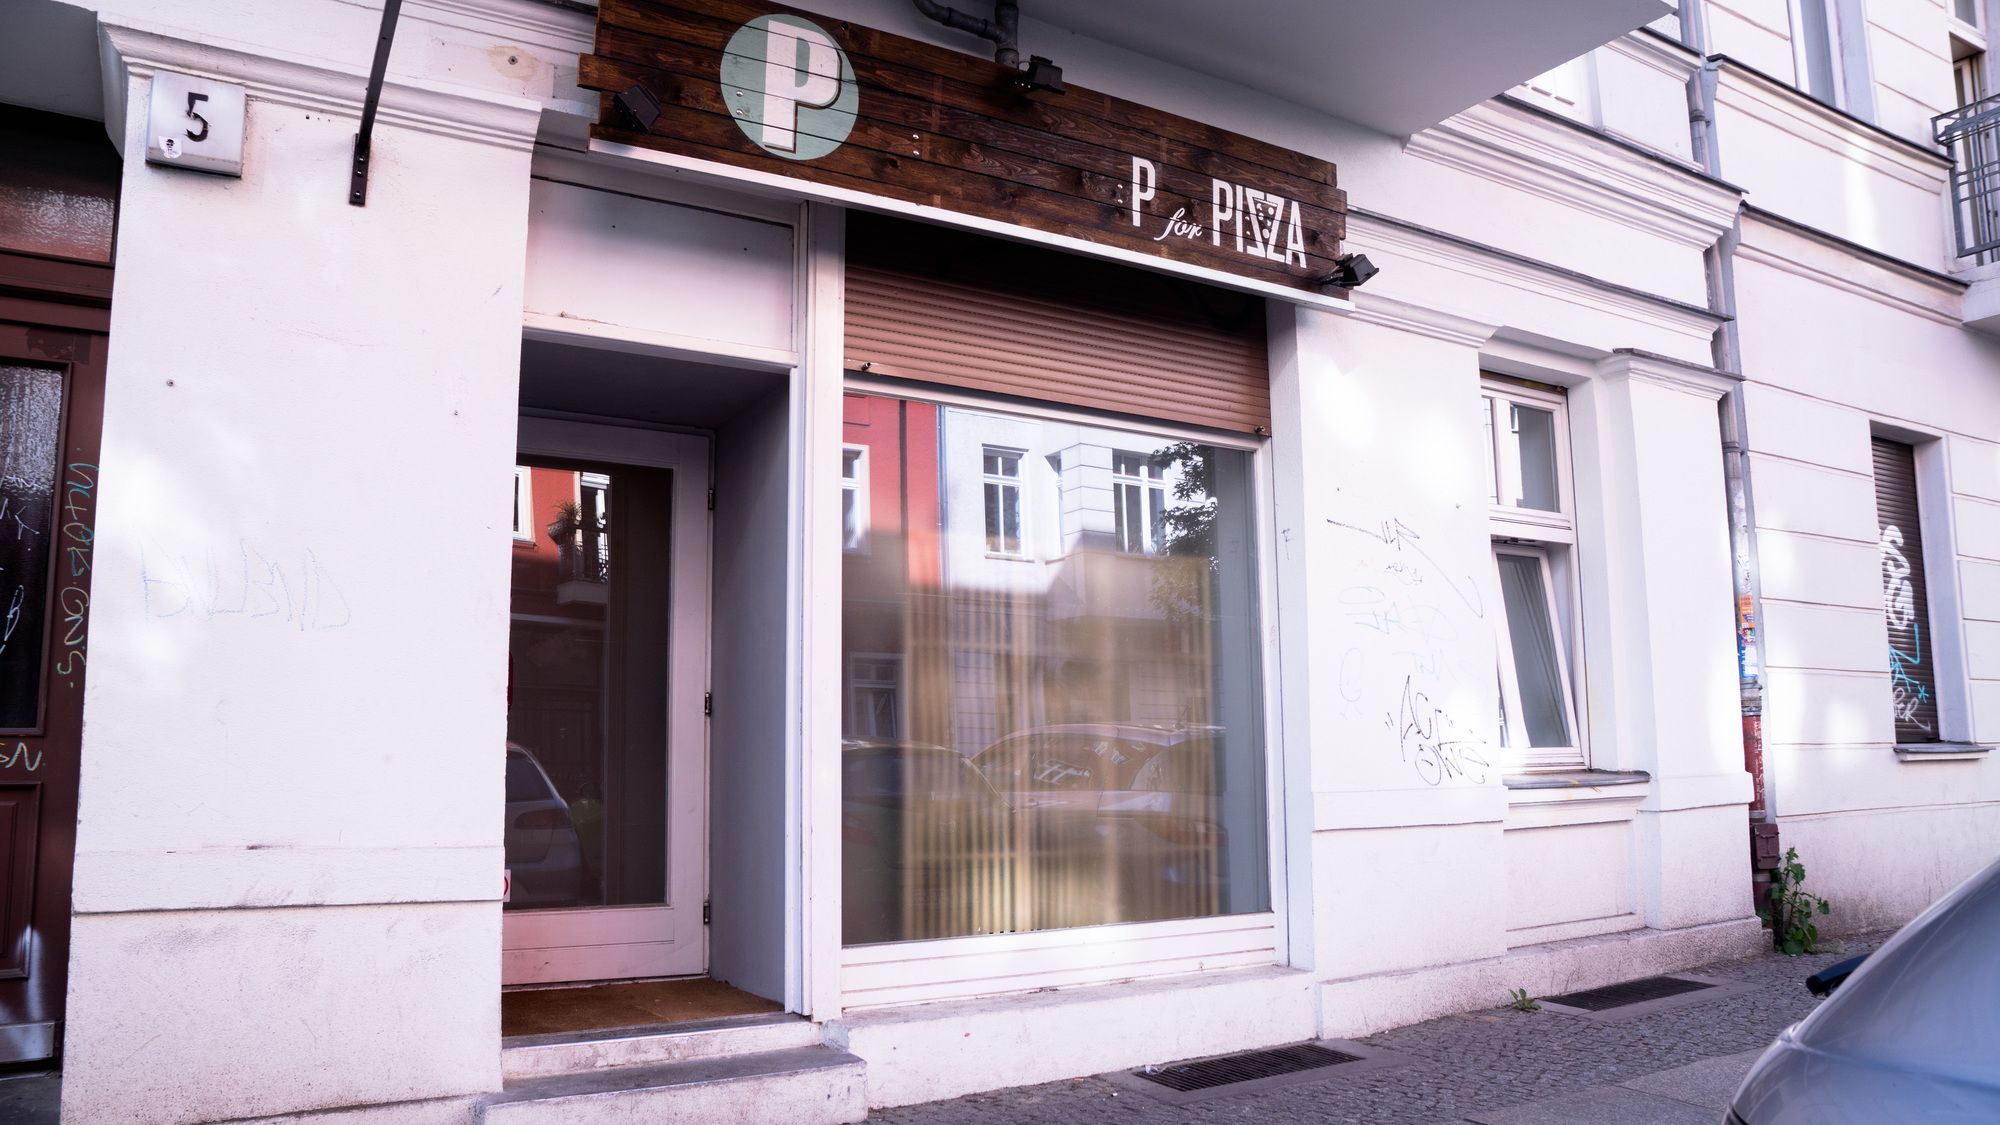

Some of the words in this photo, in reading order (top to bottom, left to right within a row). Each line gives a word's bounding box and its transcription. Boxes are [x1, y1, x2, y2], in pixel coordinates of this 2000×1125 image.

[185, 91, 209, 142] 5
[762, 20, 842, 154] P
[1132, 155, 1156, 228] P
[1153, 207, 1203, 241] for
[1212, 178, 1307, 269] PIZZA
